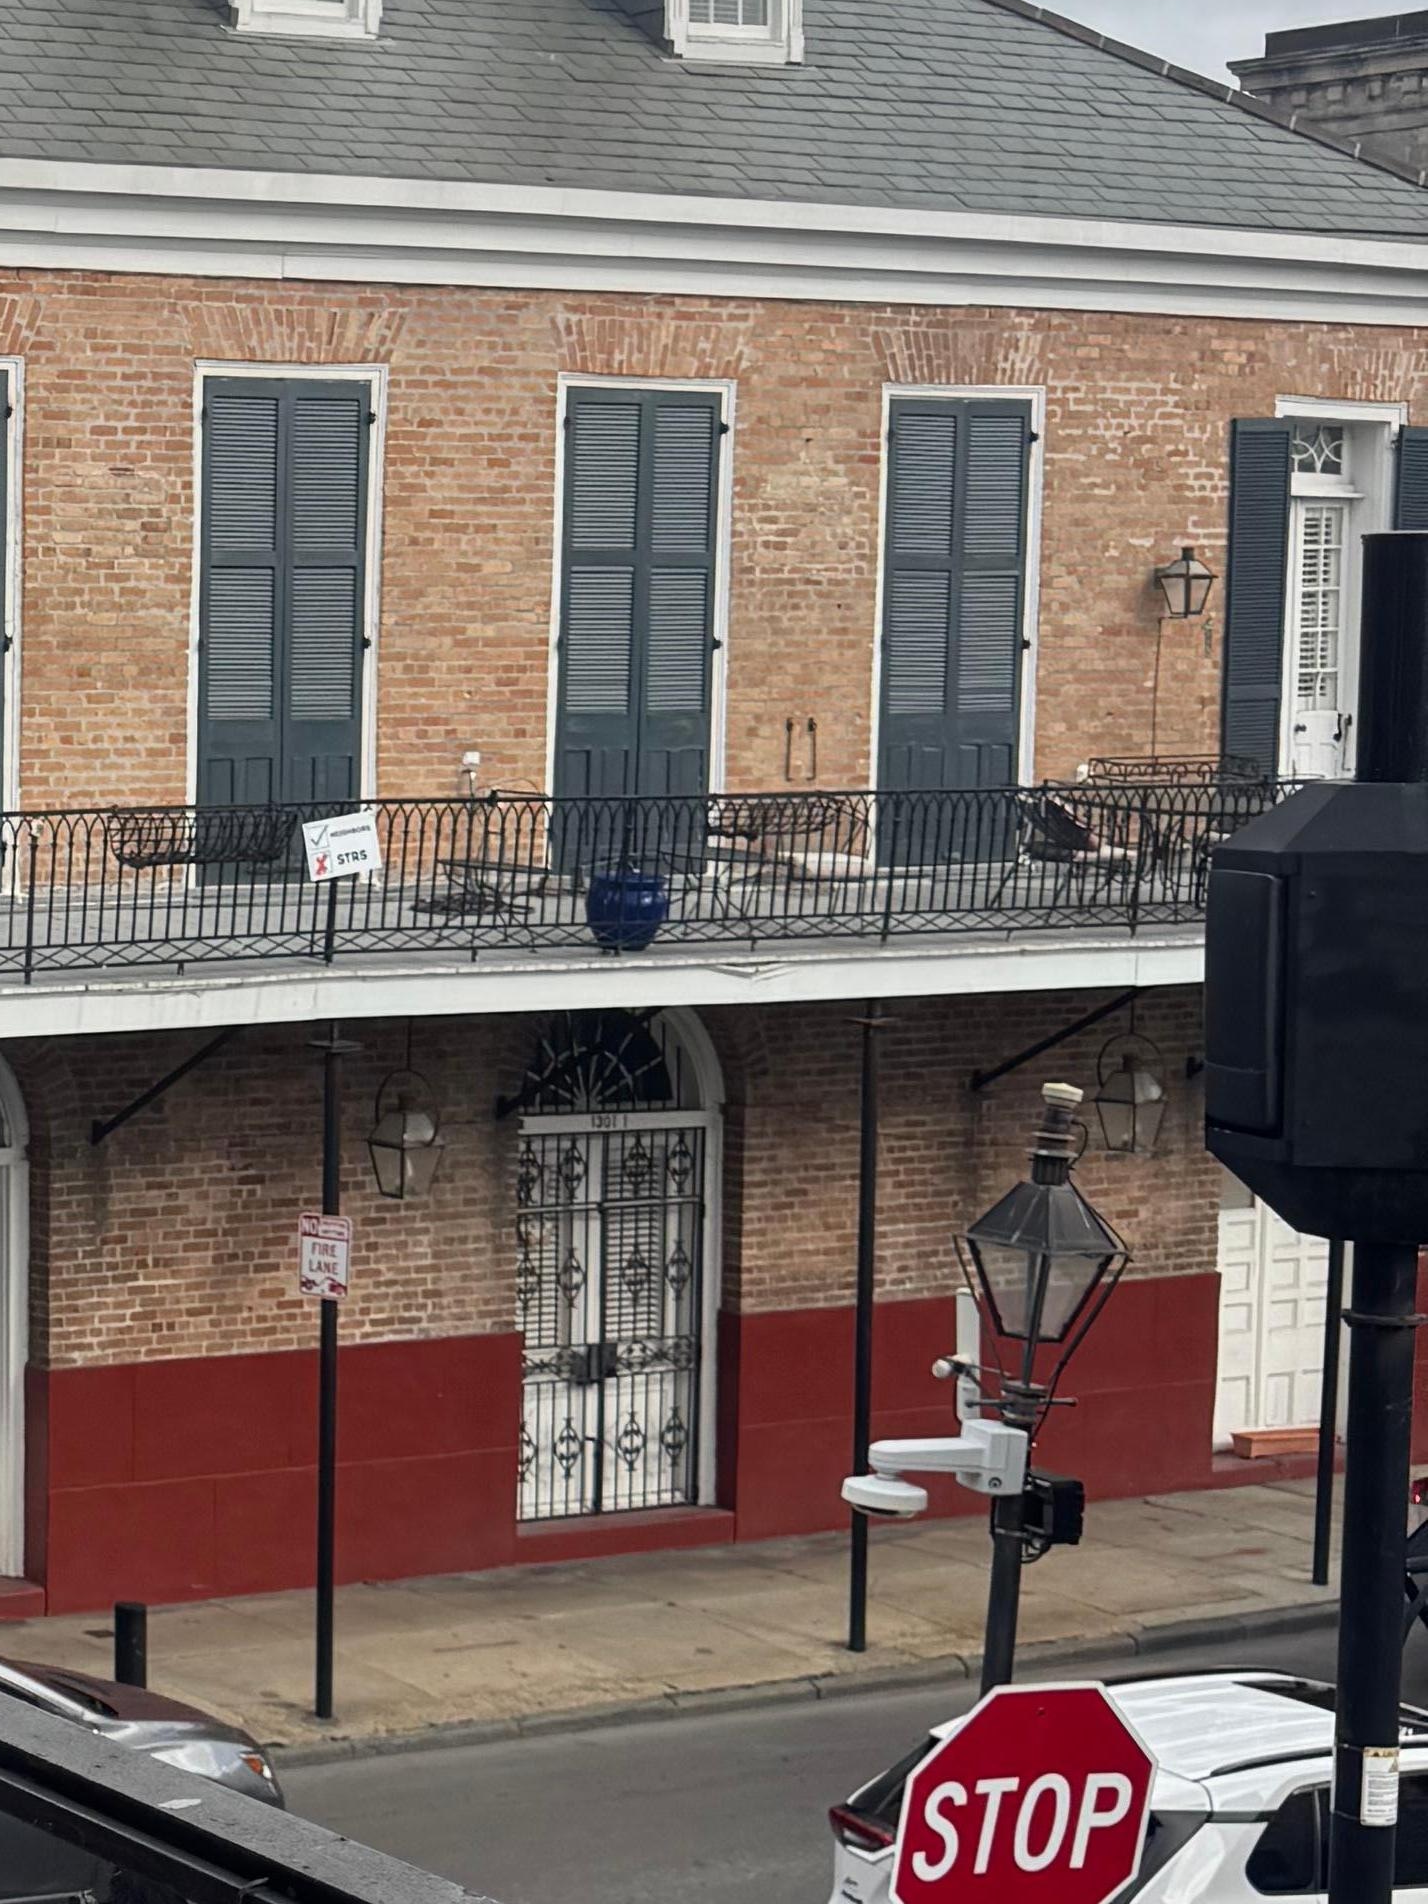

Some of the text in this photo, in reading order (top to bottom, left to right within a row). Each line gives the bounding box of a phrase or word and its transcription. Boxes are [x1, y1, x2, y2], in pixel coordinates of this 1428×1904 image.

[337, 849, 368, 865] STRS
[302, 1217, 318, 1235] NO
[312, 1242, 337, 1257] FIRE
[309, 1259, 339, 1275] LANE
[912, 1772, 1133, 1882] STOP
